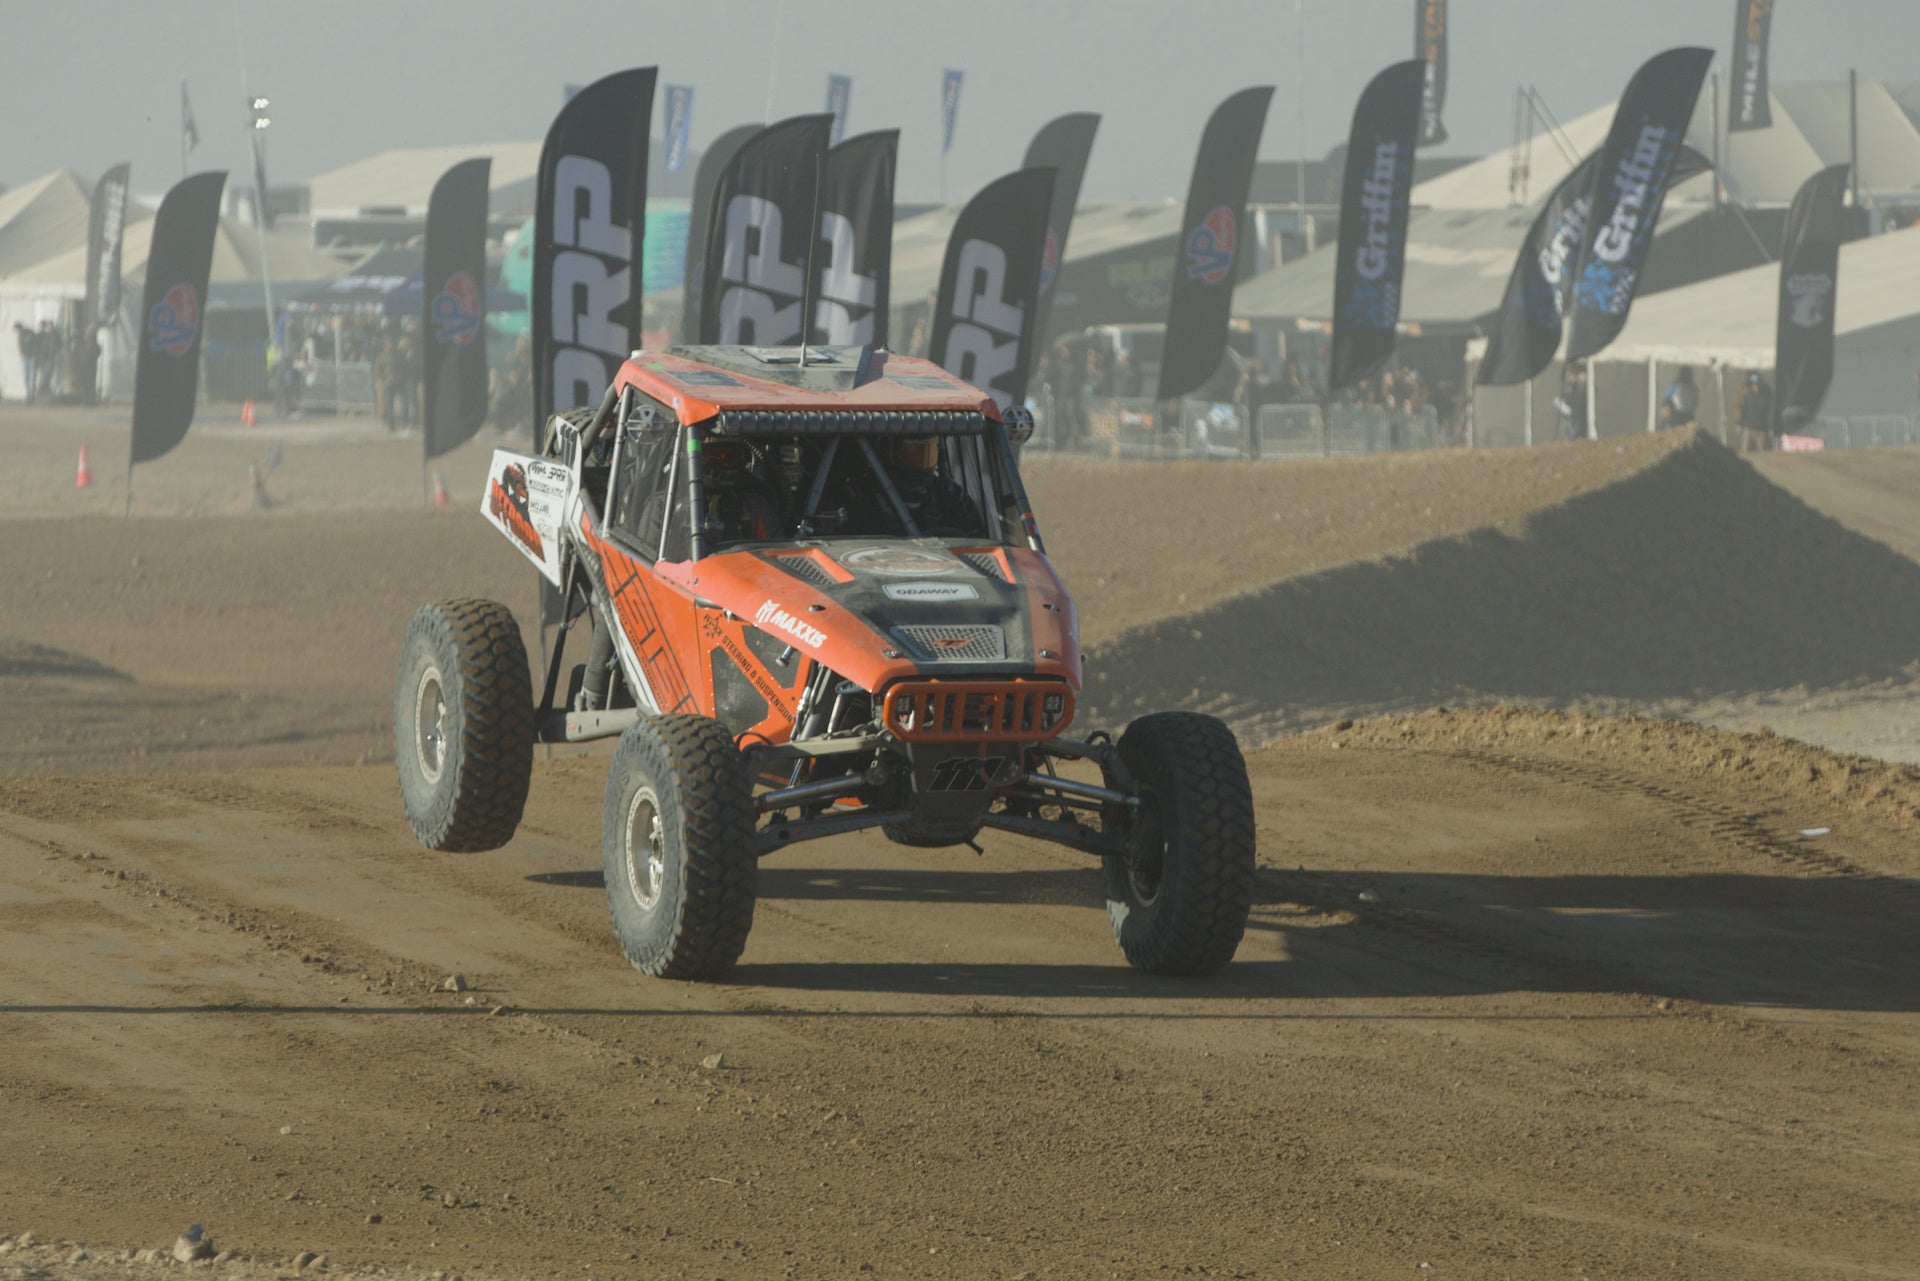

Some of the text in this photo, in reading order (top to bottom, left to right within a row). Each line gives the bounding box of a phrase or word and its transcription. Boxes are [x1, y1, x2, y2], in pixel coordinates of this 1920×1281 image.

[1356, 142, 1398, 280] Griffin
[1593, 125, 1666, 262] Griffin
[722, 635, 753, 672] STEERING
[755, 676, 794, 724] SUSPENSION
[770, 609, 828, 649] MAXXIS
